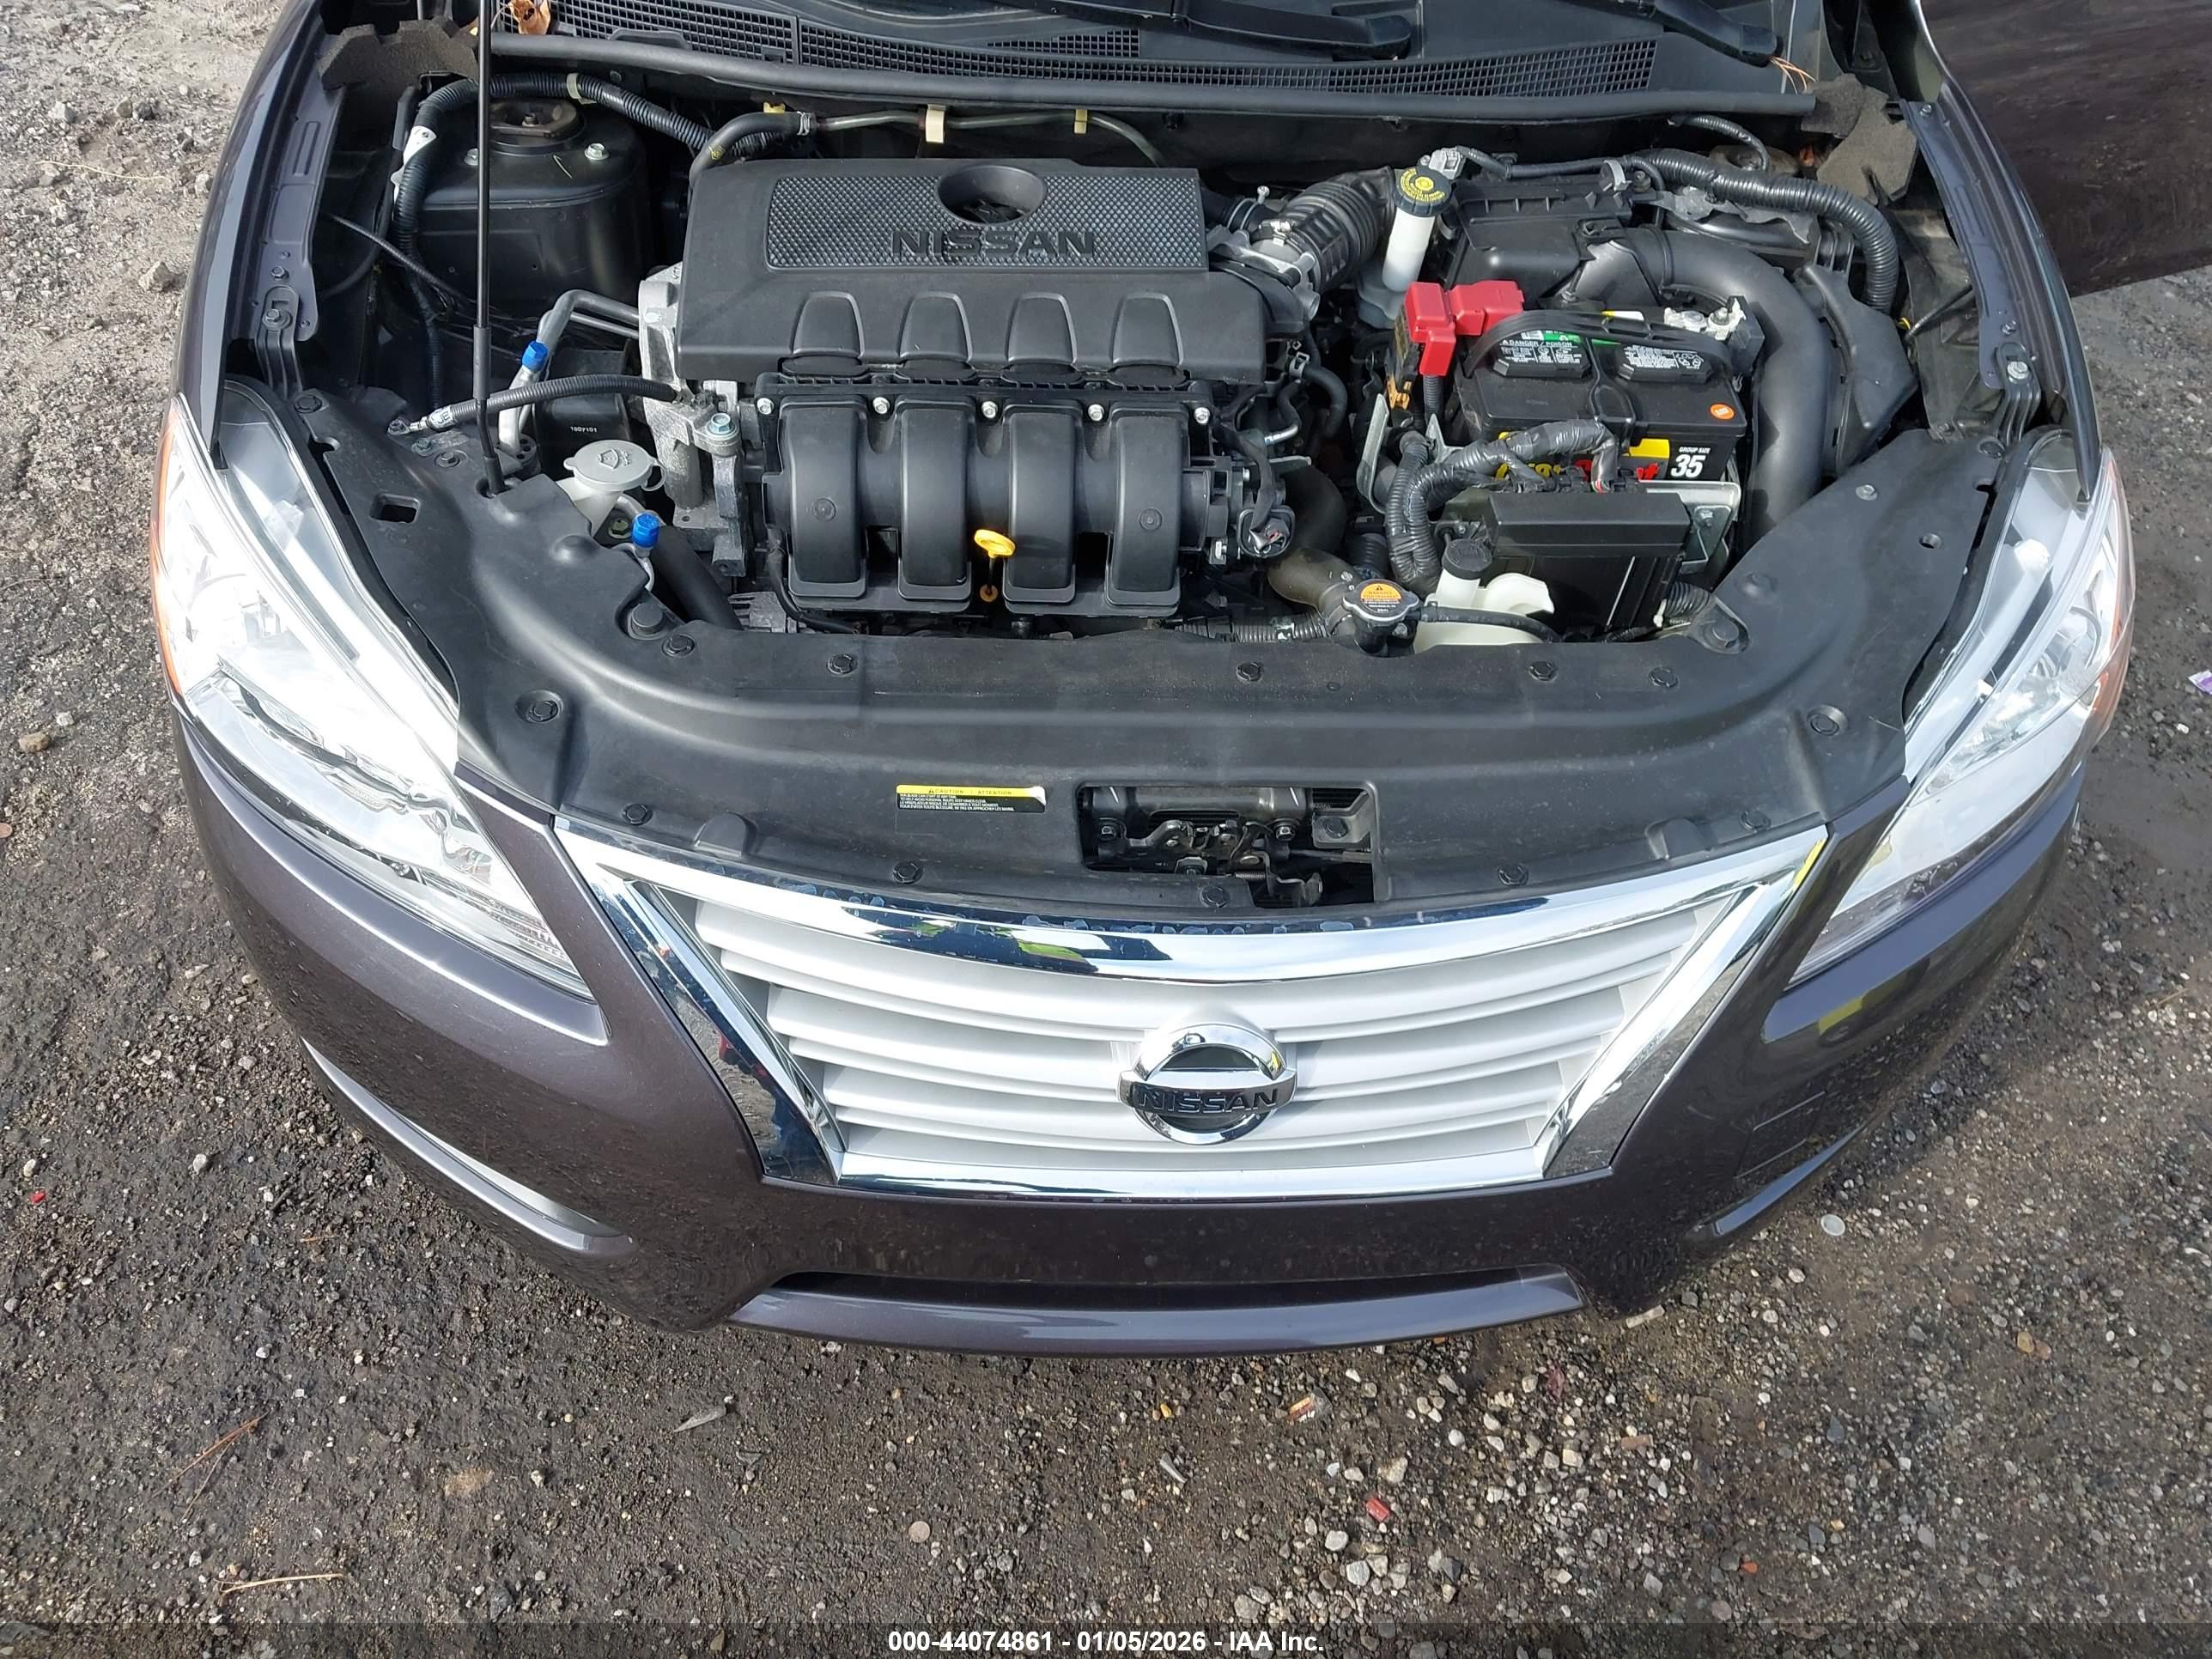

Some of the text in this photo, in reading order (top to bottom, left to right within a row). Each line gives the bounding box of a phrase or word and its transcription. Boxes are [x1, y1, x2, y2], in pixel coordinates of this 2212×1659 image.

[890, 230, 1096, 258] NISSAN
[1670, 453, 1707, 478] 35
[1138, 1088, 1279, 1115] NISSAN
